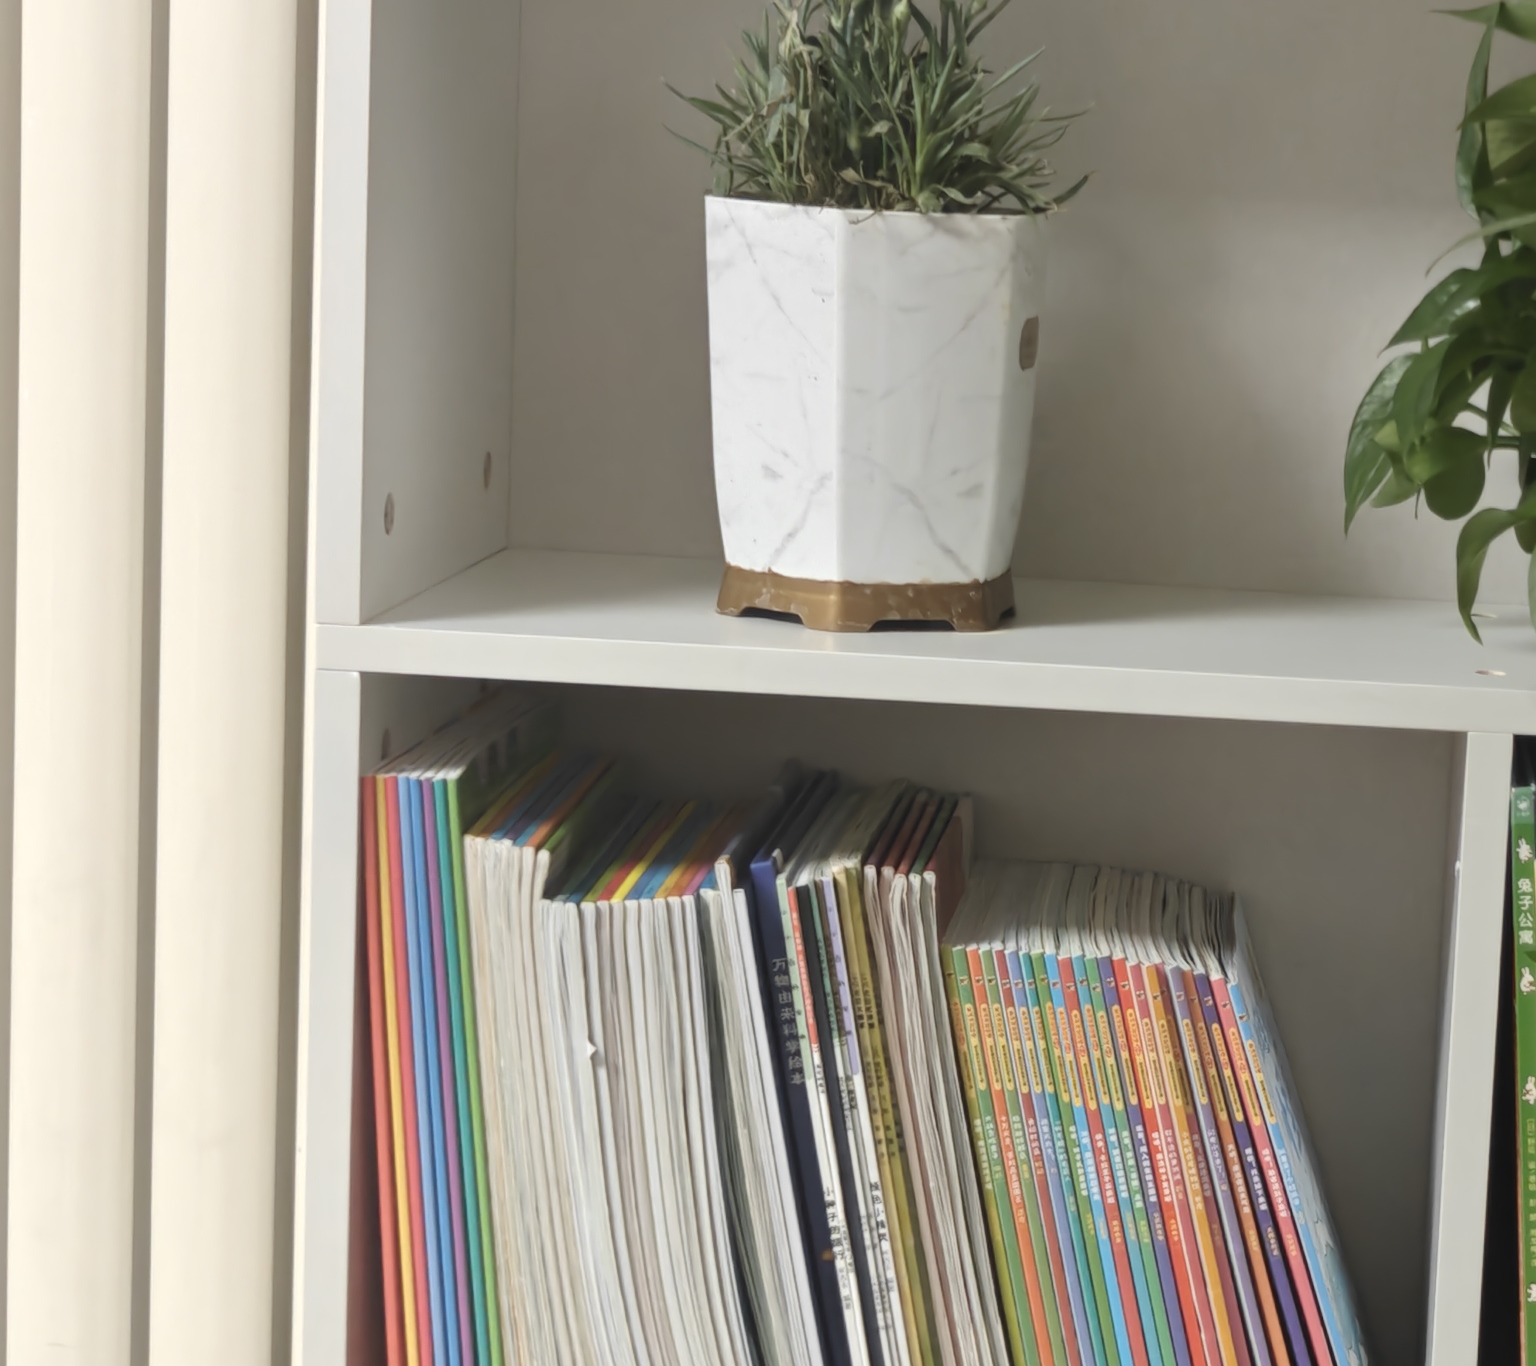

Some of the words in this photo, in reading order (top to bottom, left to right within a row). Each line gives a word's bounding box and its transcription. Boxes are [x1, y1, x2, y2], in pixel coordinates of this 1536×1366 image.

[1517, 878, 1534, 945] 兔子公寓
[772, 957, 806, 1085] 万物由来科学绘本
